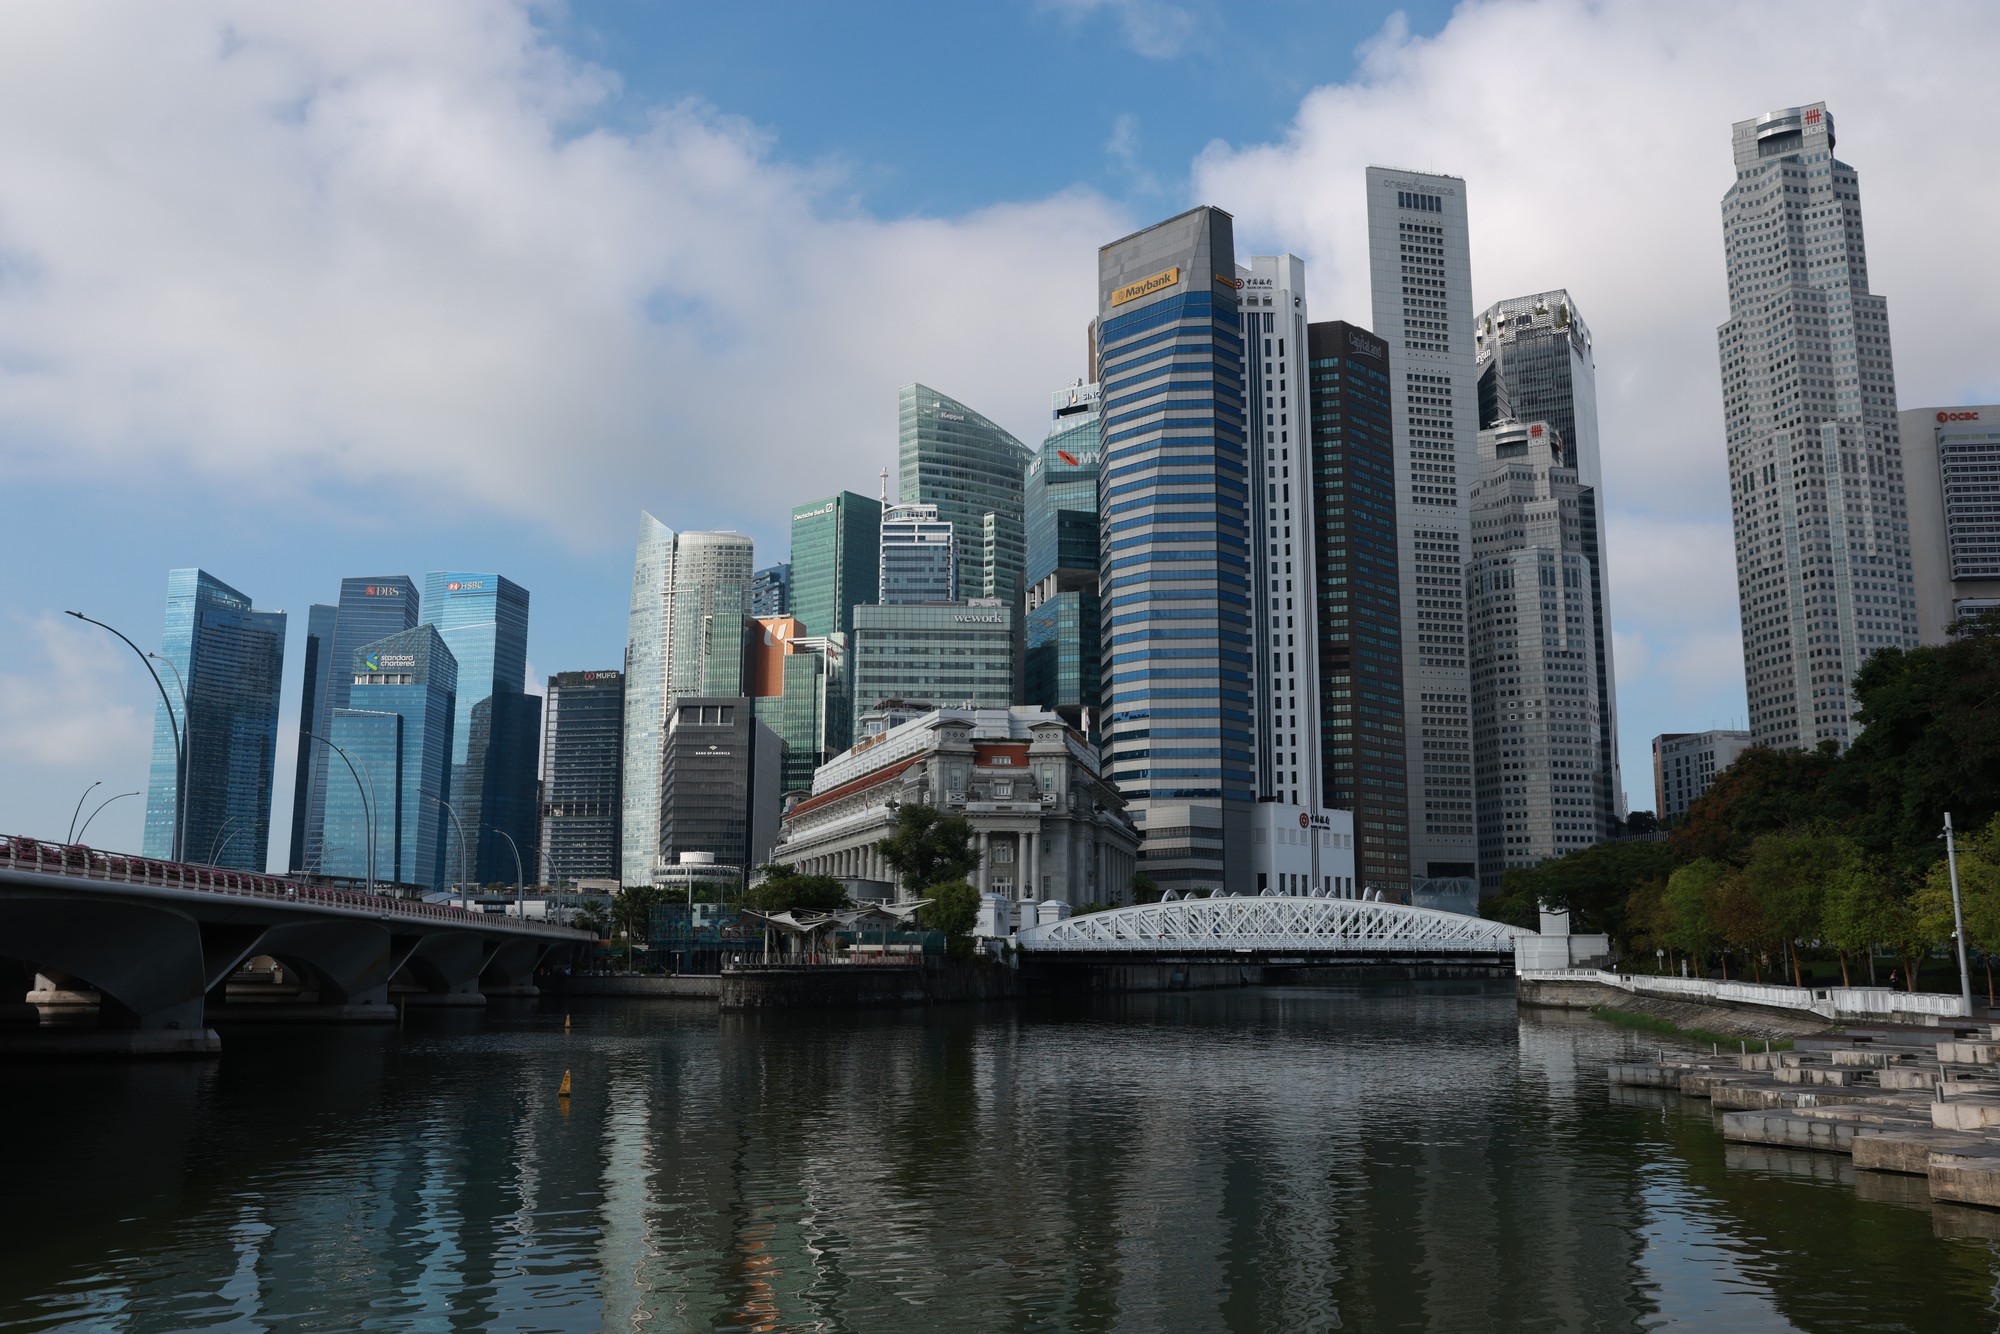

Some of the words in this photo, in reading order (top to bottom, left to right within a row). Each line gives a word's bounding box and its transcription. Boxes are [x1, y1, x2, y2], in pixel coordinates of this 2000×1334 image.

[1802, 124, 1826, 136] UOB
[1125, 274, 1171, 298] Maybank
[1949, 412, 1979, 421] OCBC
[1528, 438, 1547, 448] UOB
[461, 581, 484, 589] HSBC
[376, 586, 399, 596] DBS
[954, 611, 1003, 623] wework
[596, 671, 617, 679] MUFG
